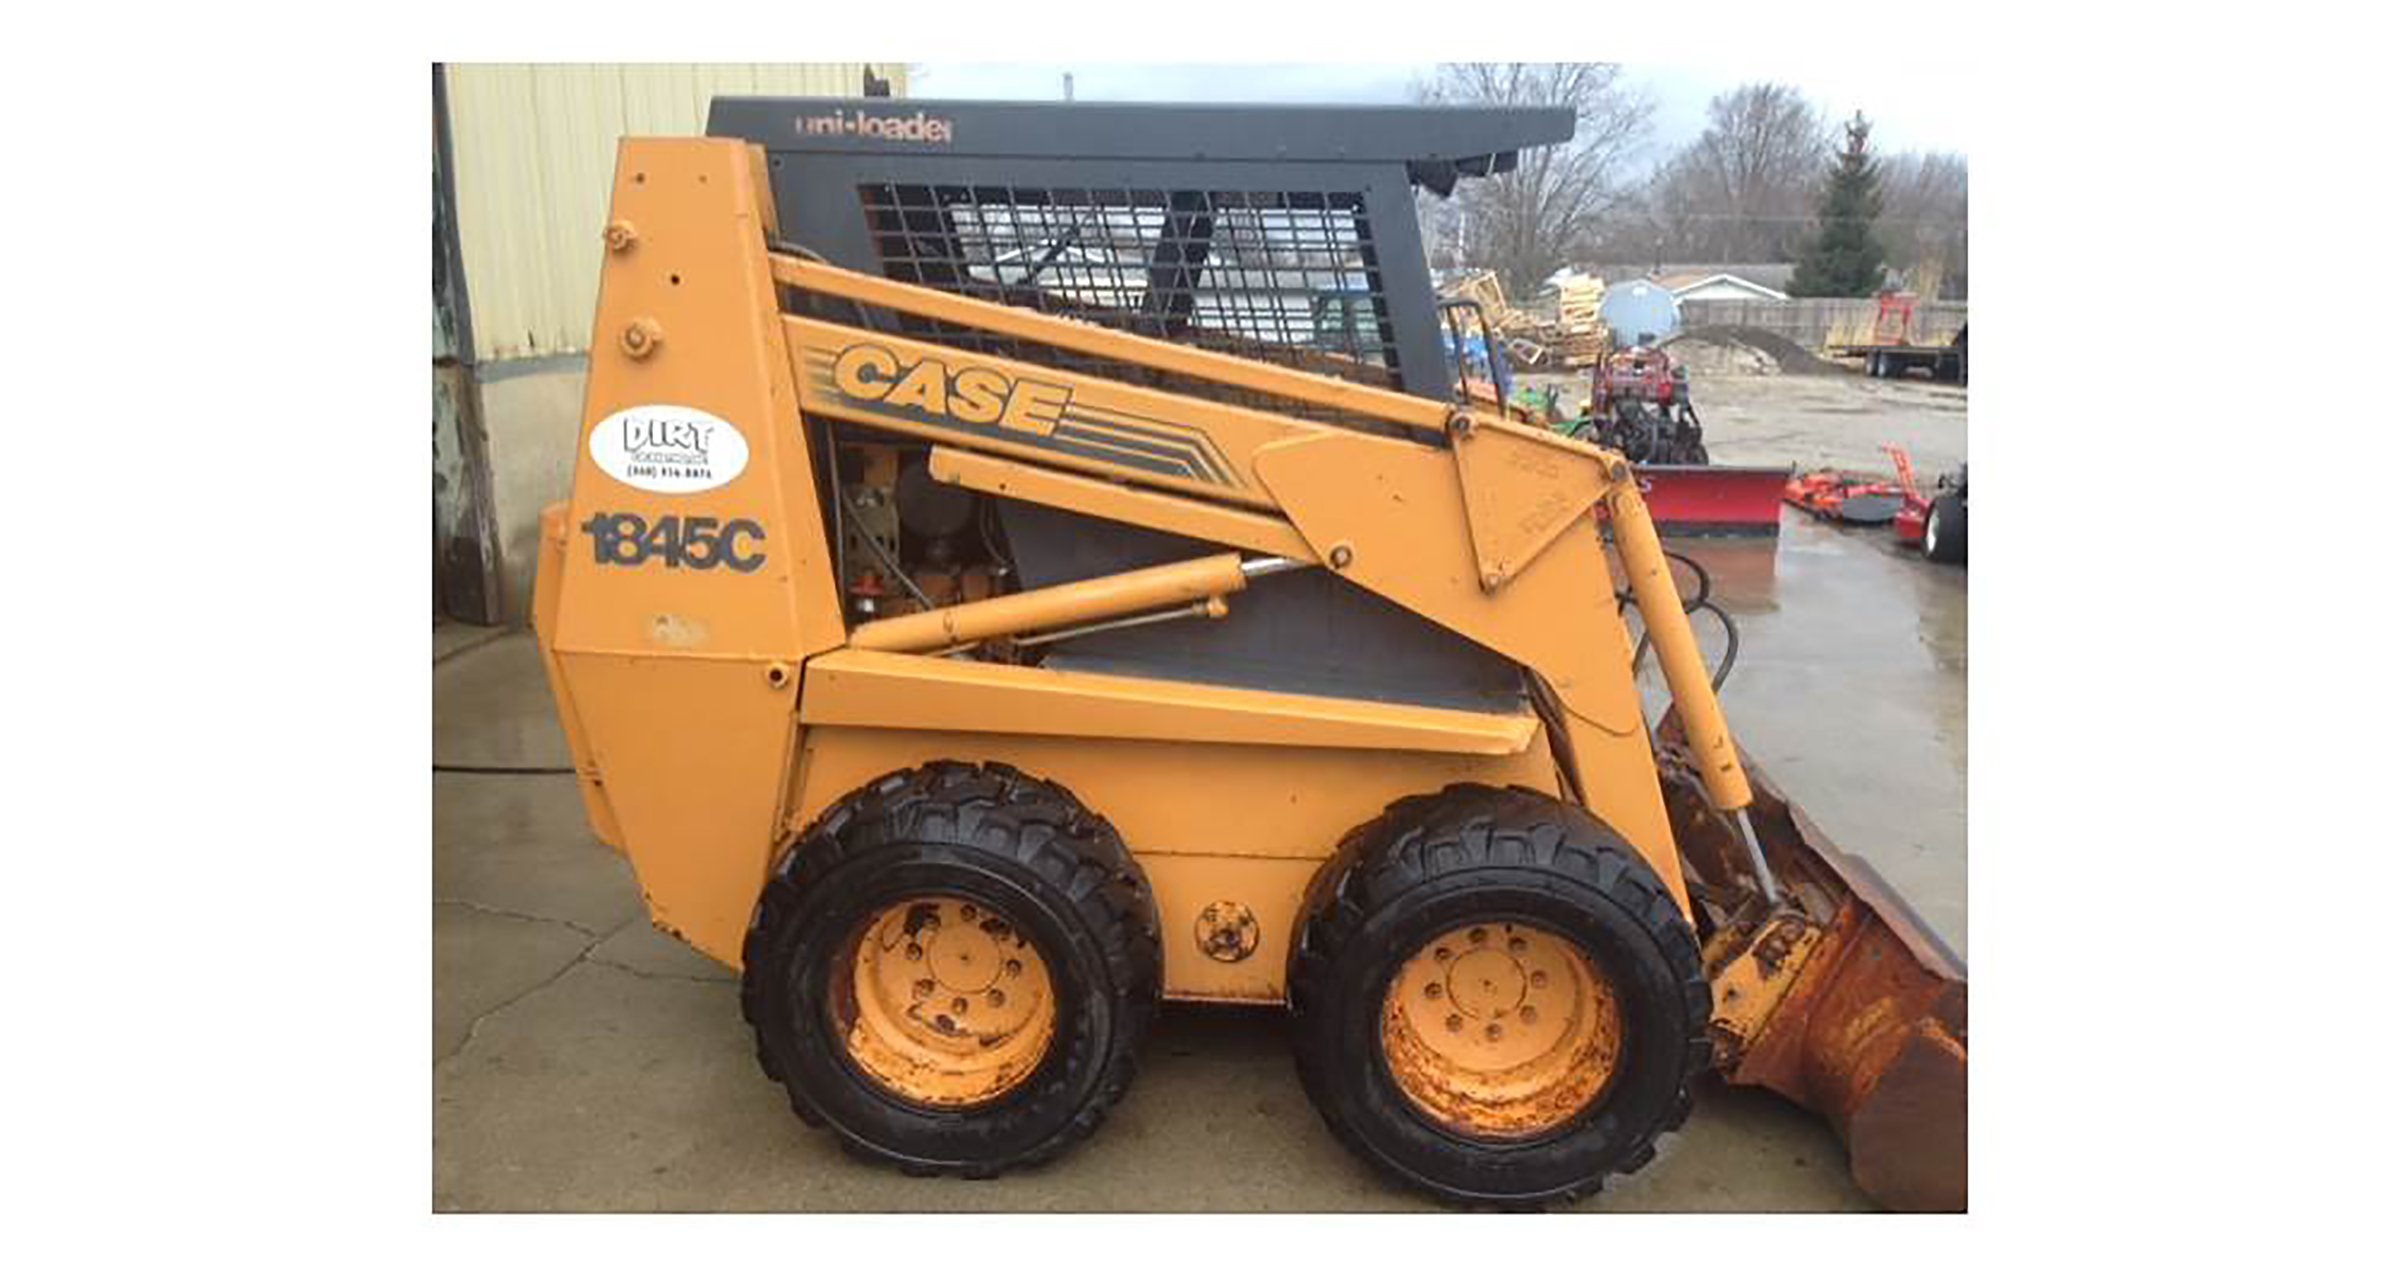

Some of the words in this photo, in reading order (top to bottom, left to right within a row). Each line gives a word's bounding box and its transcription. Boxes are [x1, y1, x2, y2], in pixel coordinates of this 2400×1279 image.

[833, 343, 1075, 437] CASE
[623, 417, 715, 455] DIRT
[582, 511, 767, 573] 1845C
